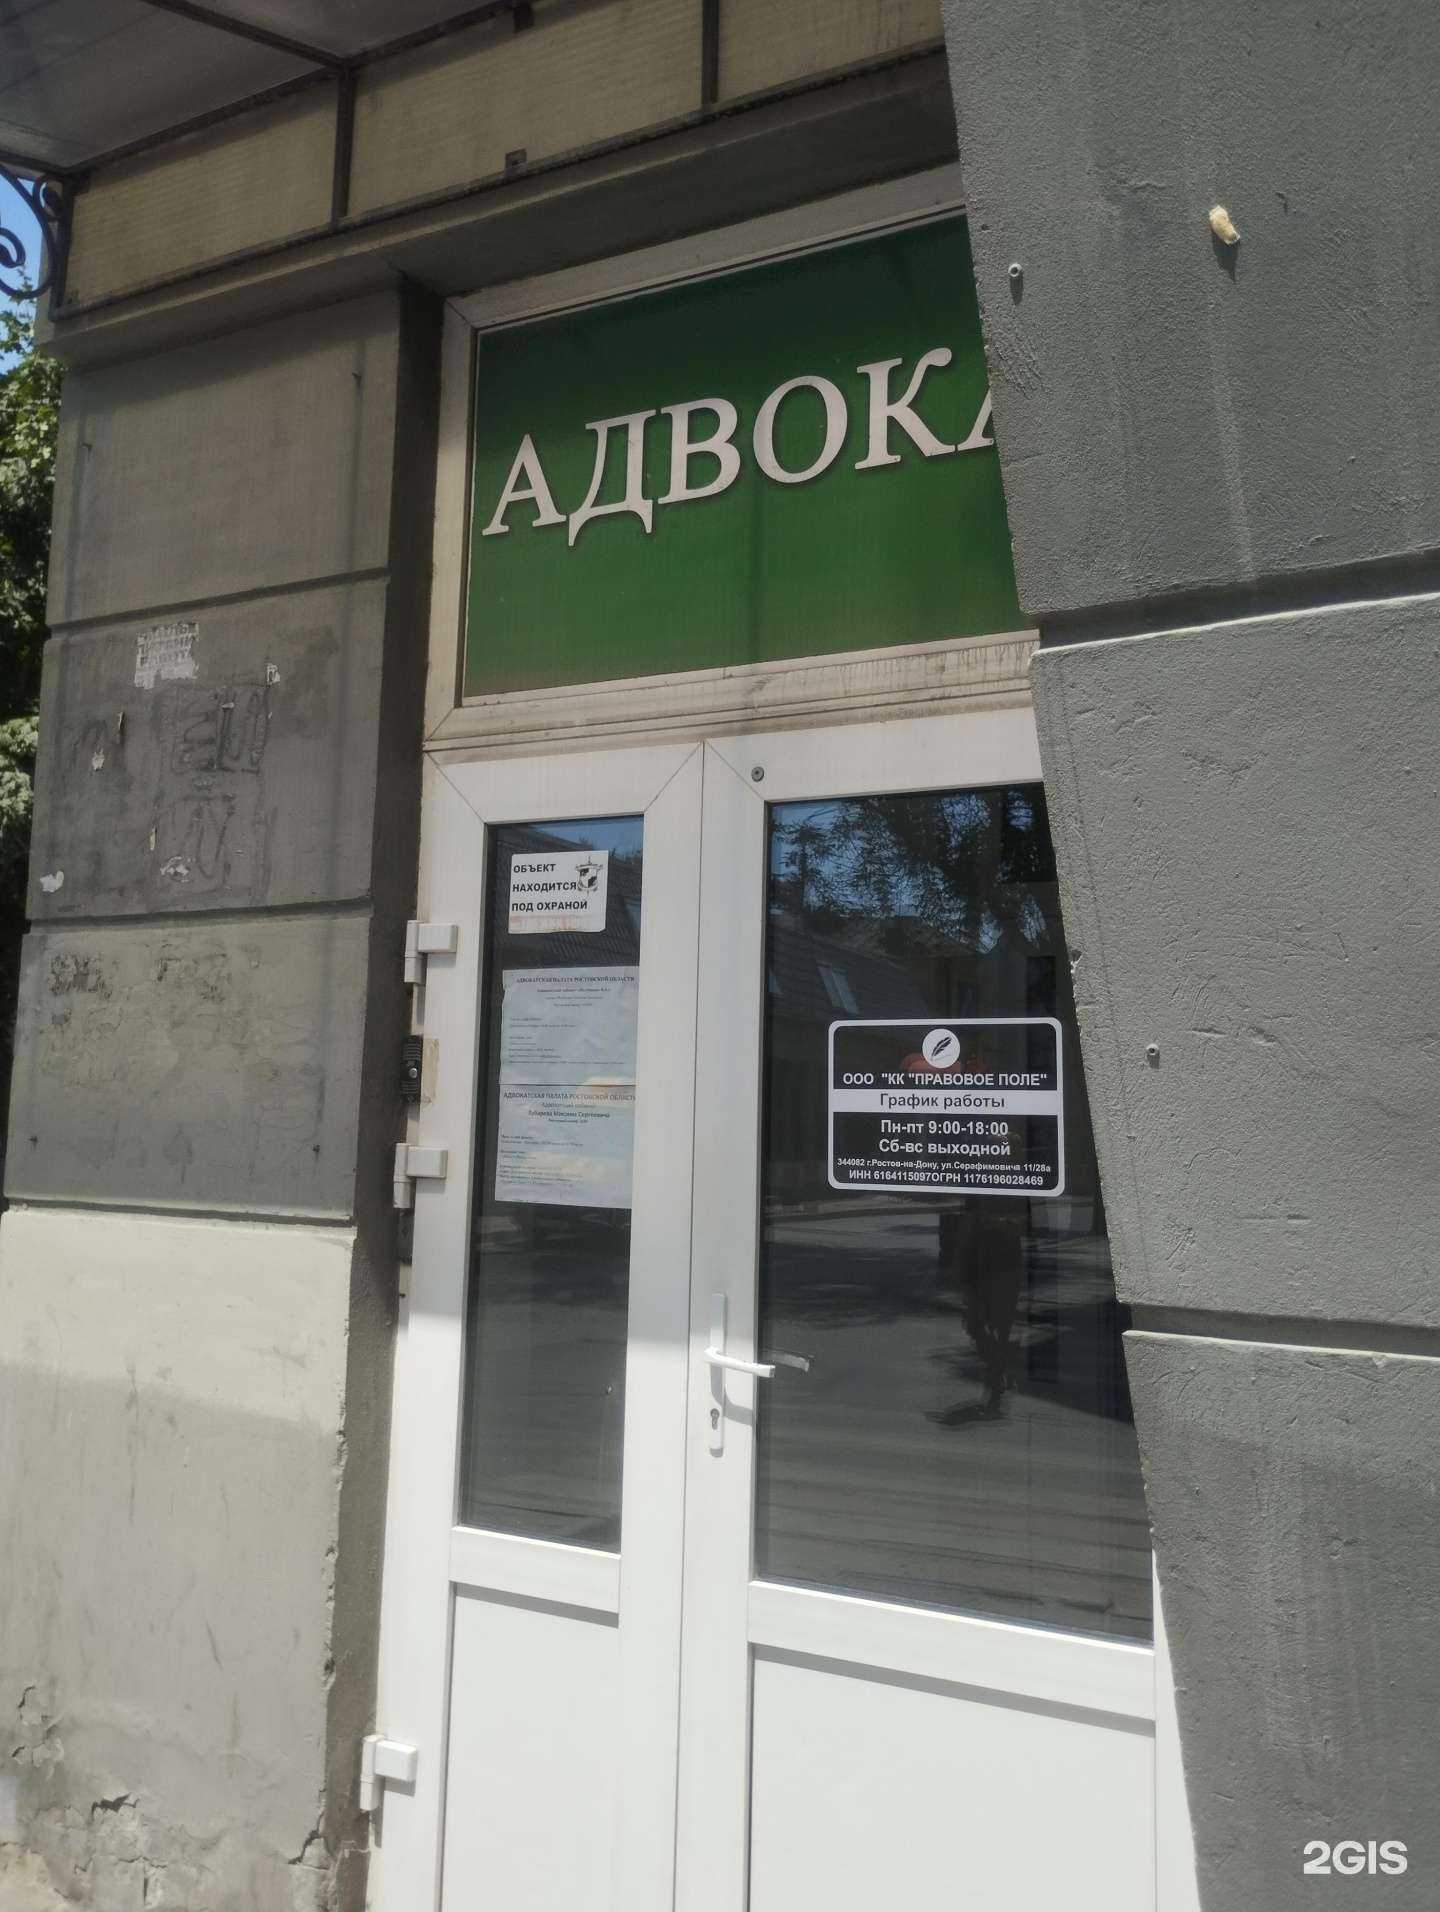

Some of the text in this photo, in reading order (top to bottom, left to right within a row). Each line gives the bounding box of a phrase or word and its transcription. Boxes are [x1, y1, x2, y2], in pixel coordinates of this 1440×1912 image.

[513, 863, 556, 873] ОБЪЕКТ
[512, 881, 577, 893] НАХОДИТСЯ
[511, 899, 588, 913] ПОД ОХРАНОЙ
[842, 1072, 1047, 1086] ООО "КК "ПРАВОВОЕ ПОЛЕ"
[880, 1093, 1005, 1110] График работы
[881, 1119, 1009, 1136] Пн-пт 9:00-18:00
[879, 1138, 1011, 1157] Сб-вс выходной
[1023, 1163, 1051, 1172] 11/28а
[849, 1170, 872, 1180] ИНН
[963, 1173, 1044, 1186] 1176196028469
